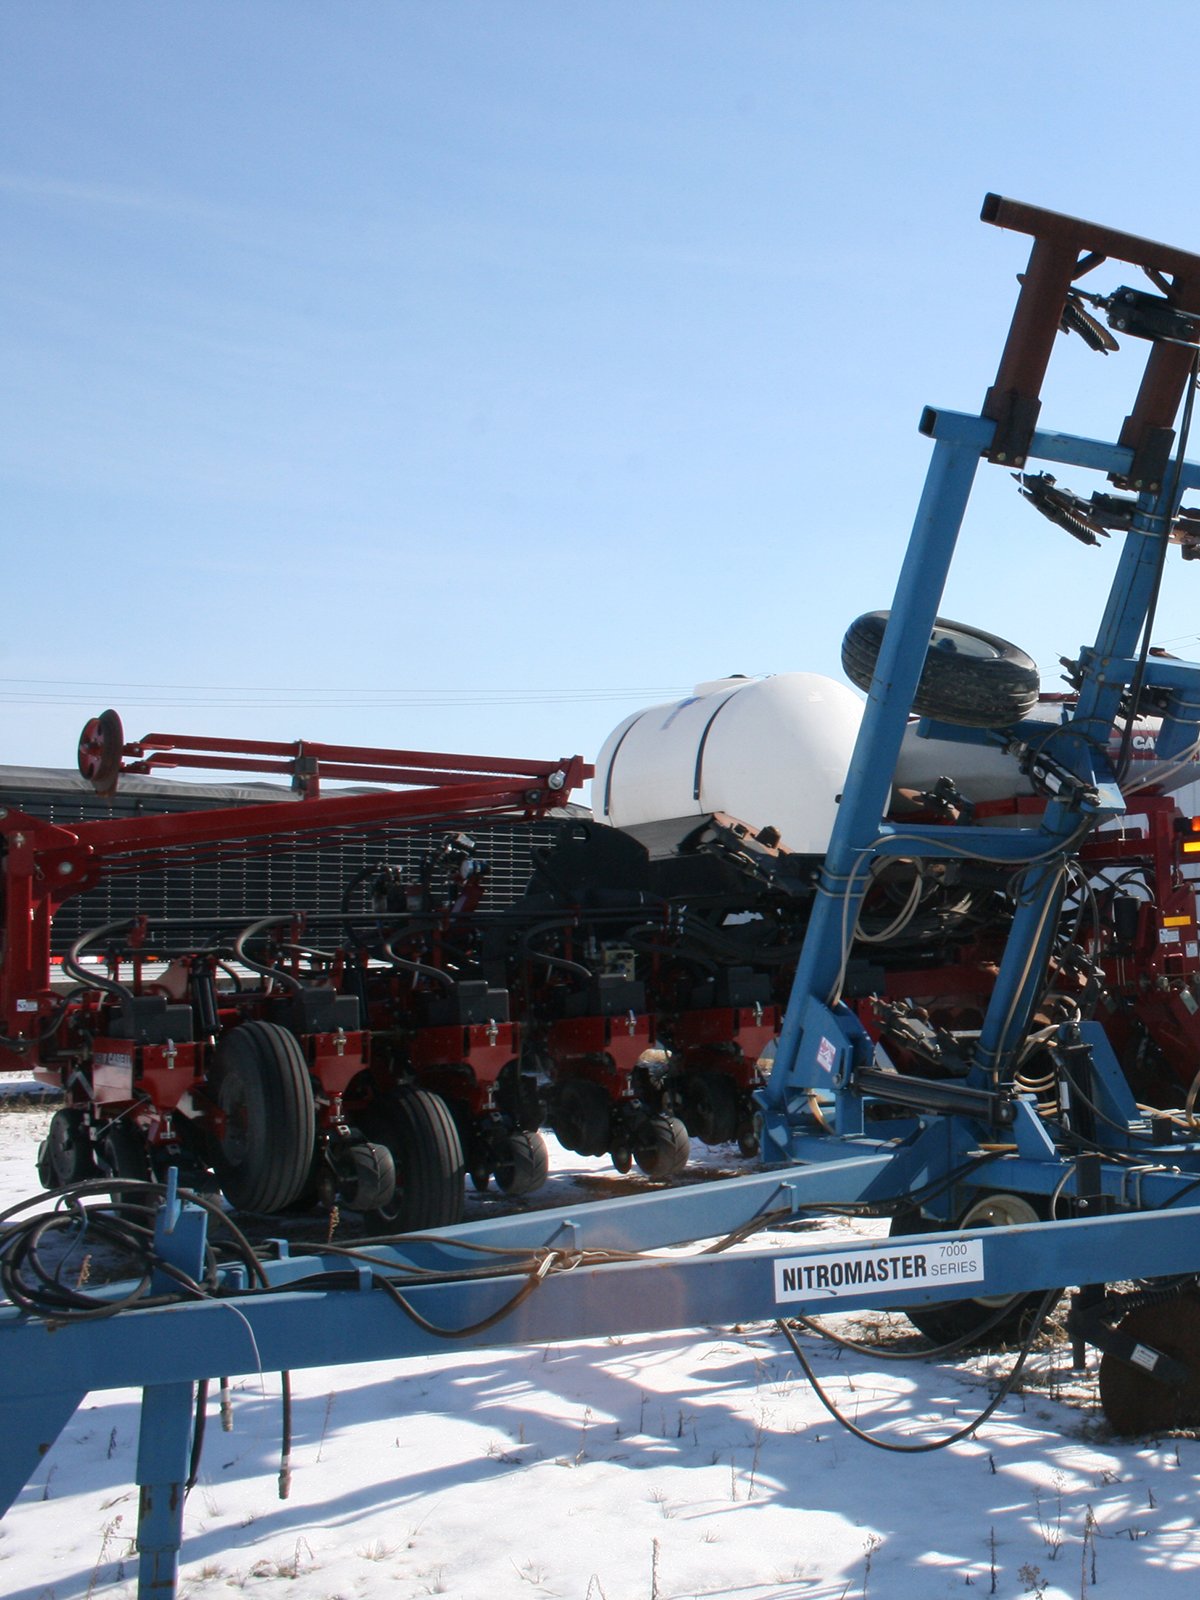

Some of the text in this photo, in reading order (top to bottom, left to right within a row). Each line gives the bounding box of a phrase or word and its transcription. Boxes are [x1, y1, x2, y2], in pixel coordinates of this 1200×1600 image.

[1132, 735, 1157, 750] CA
[939, 1244, 968, 1258] 7000
[782, 1254, 927, 1292] NITROMASTER
[931, 1260, 977, 1277] SERIES
